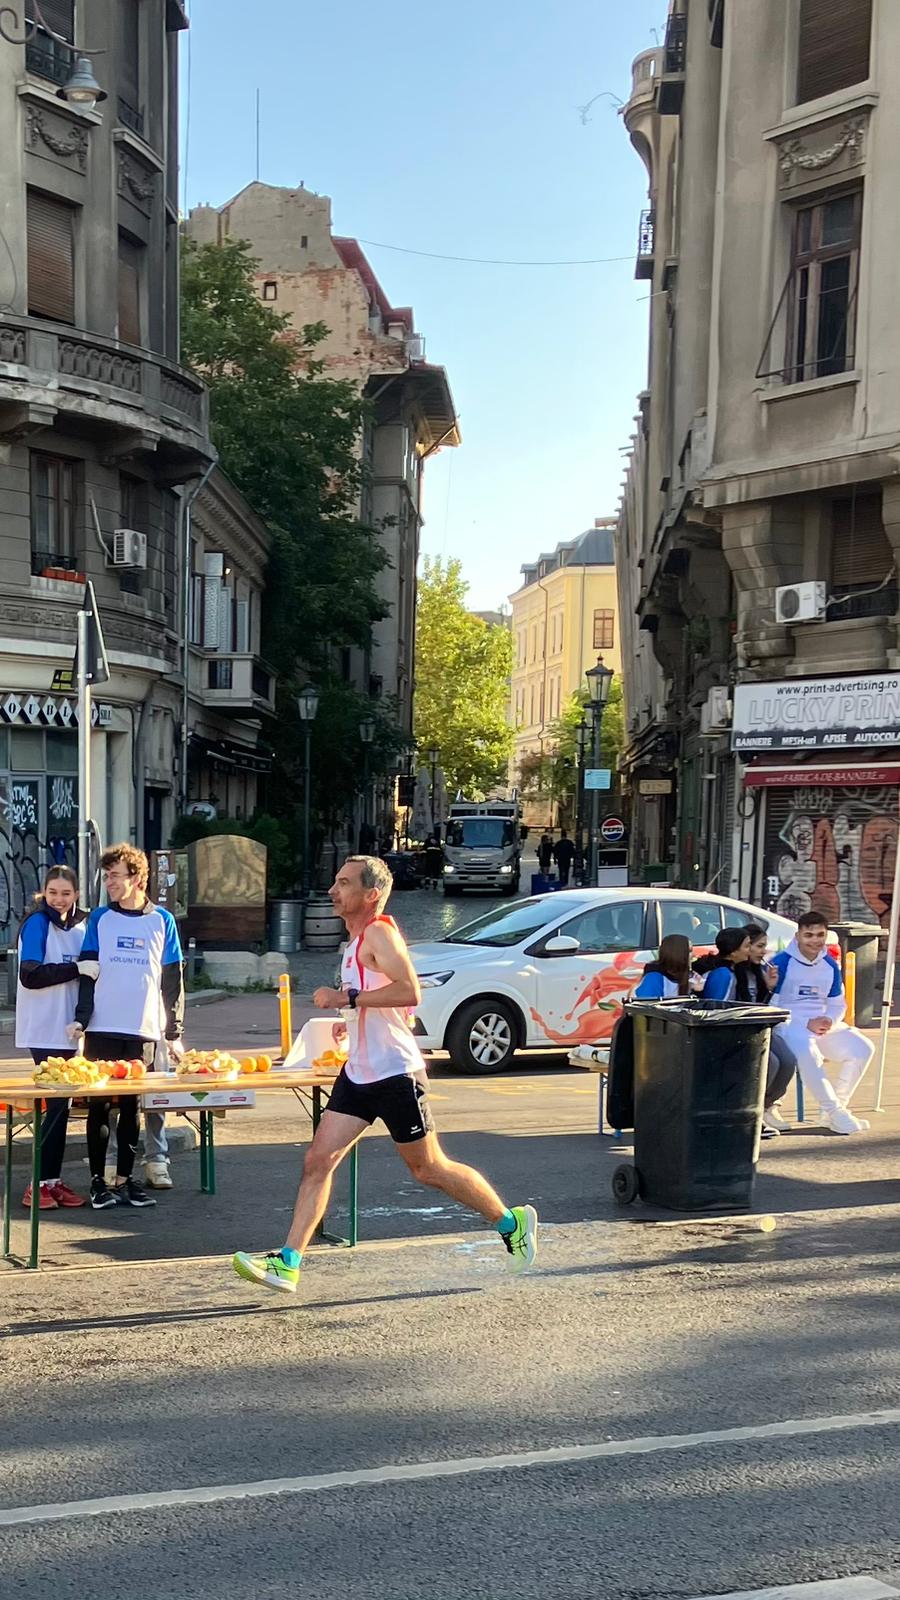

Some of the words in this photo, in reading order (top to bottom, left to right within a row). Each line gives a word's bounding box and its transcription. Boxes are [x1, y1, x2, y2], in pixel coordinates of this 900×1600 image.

[776, 680, 898, 696] www.print-advertising.ro
[749, 696, 835, 725] LUCKY
[735, 737, 773, 747] BANNERE
[823, 733, 847, 743] AFISE
